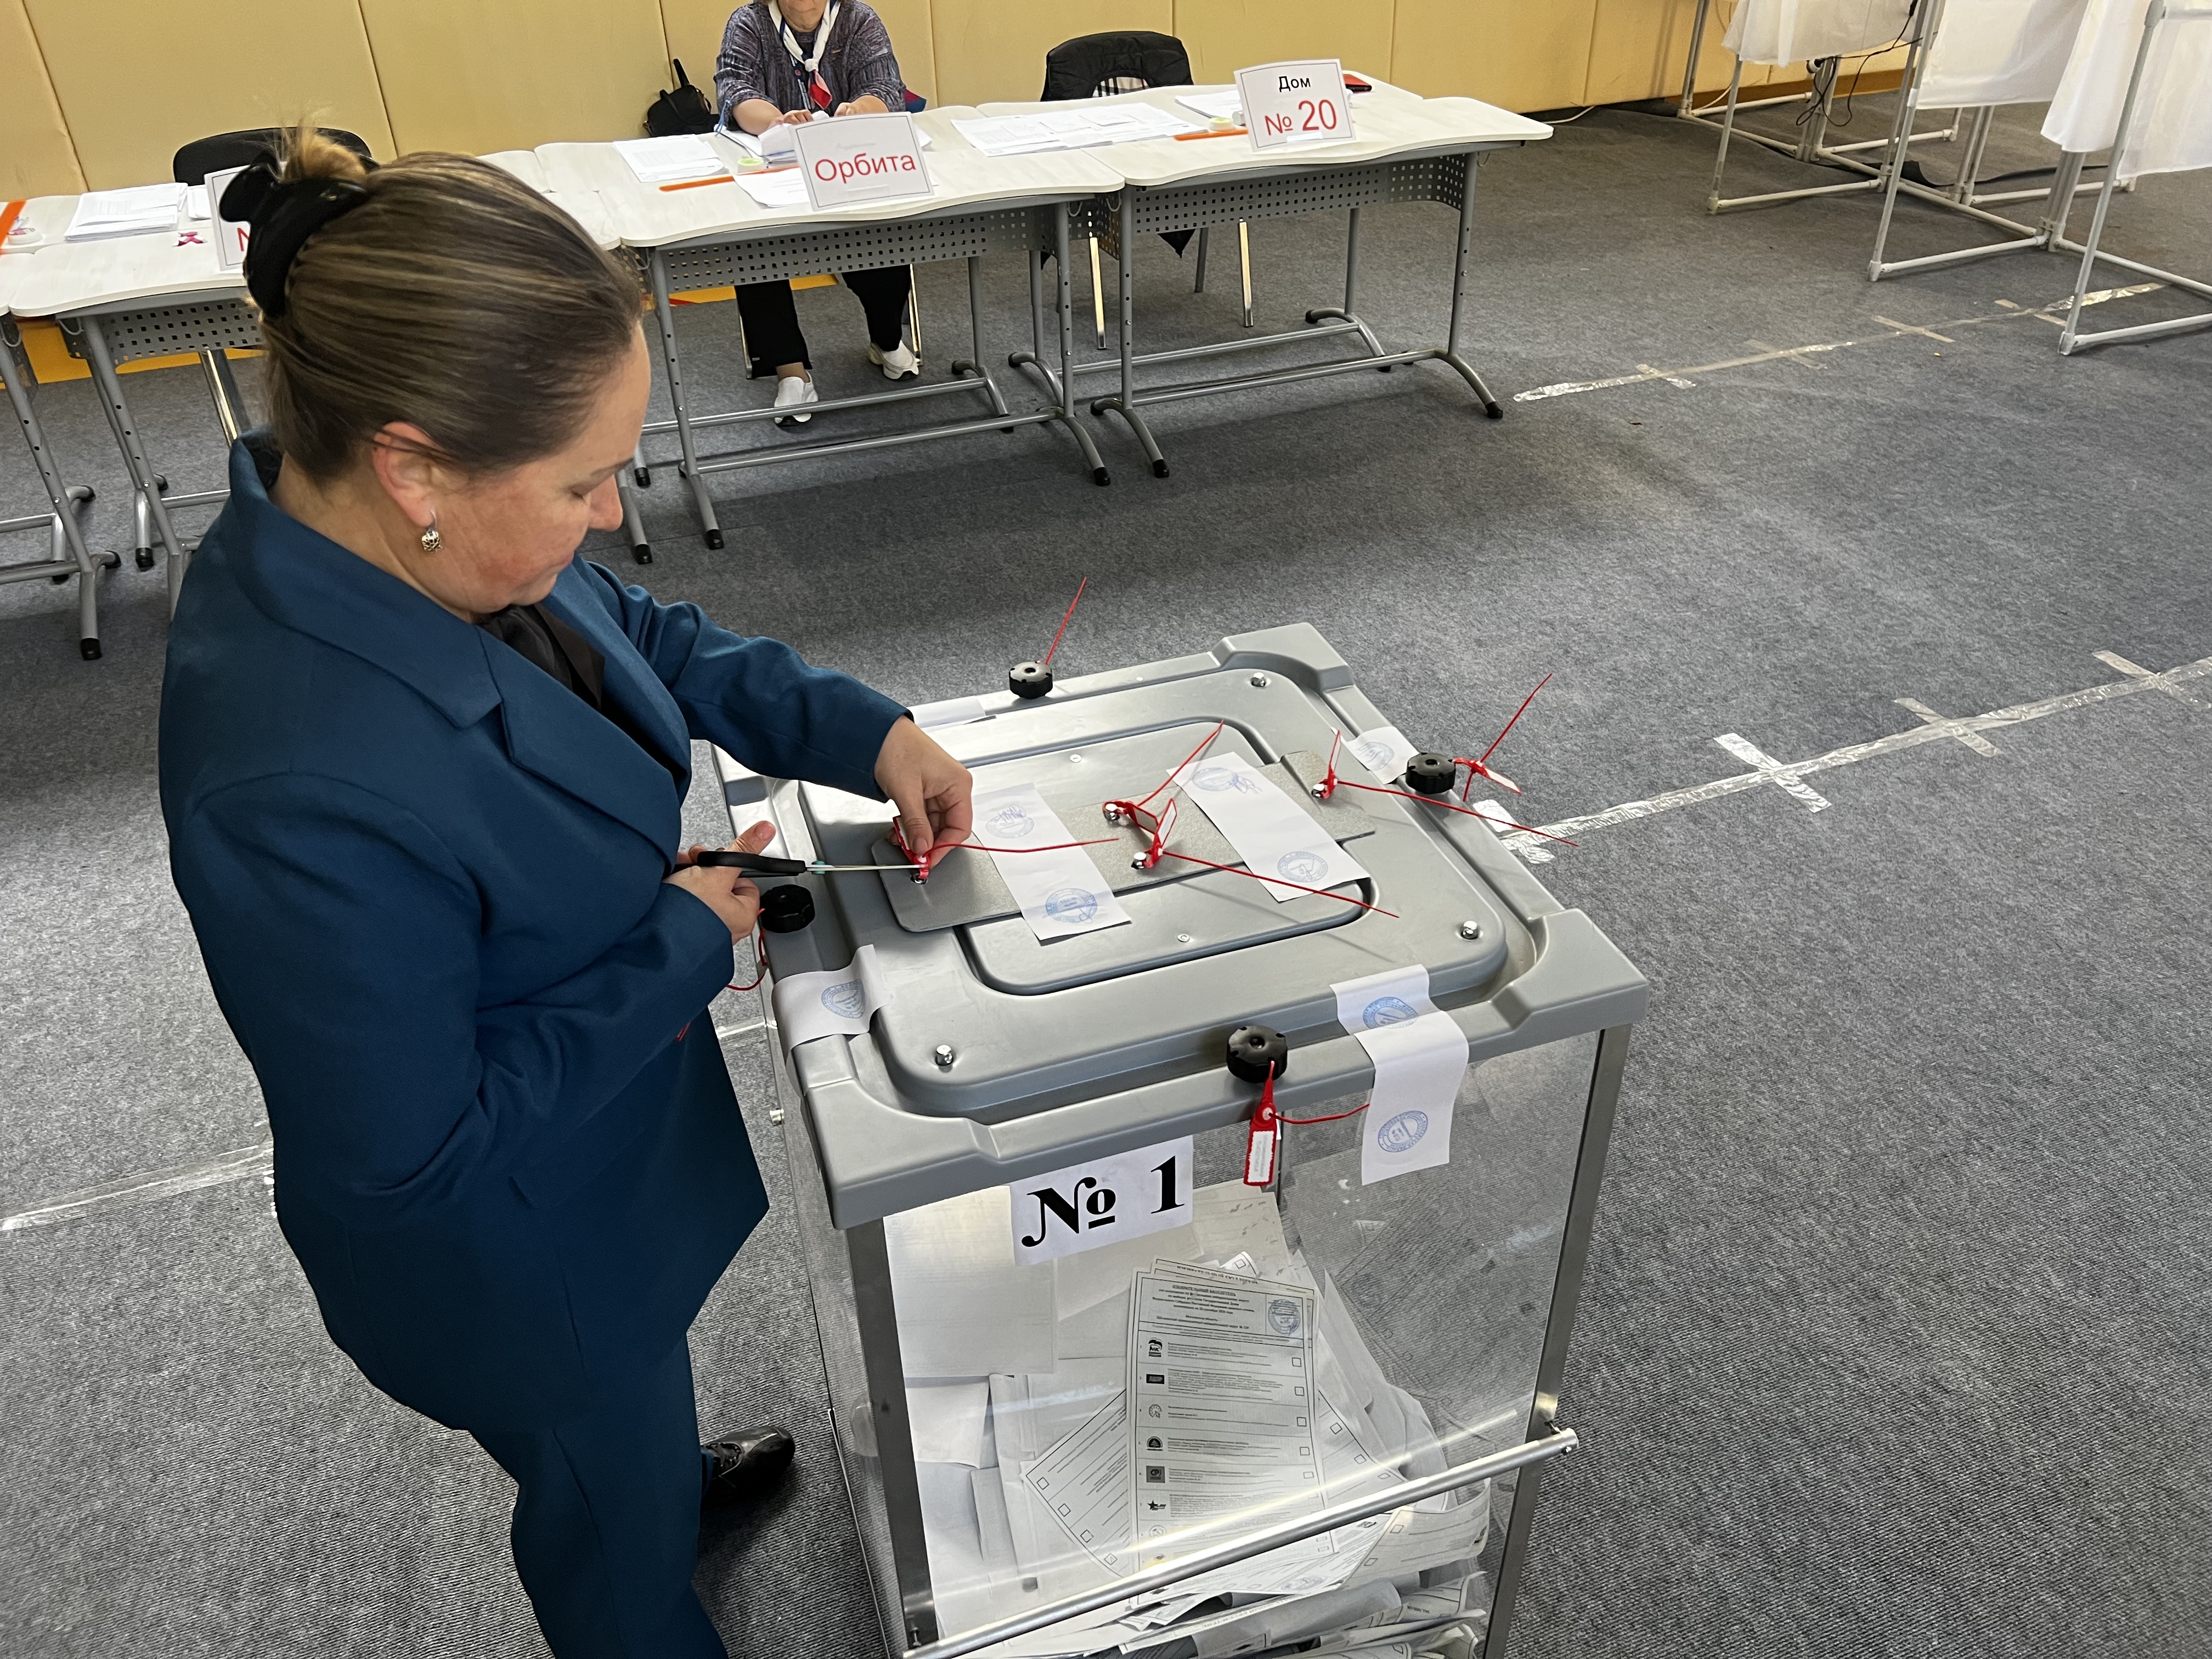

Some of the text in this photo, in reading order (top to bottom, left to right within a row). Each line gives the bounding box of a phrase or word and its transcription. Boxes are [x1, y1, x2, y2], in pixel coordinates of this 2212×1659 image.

[1279, 76, 1311, 92] Дом
[1264, 99, 1337, 136] № 20
[815, 153, 916, 184] Орбита
[1021, 1176, 1116, 1248] №
[1150, 1155, 1186, 1214] 1
